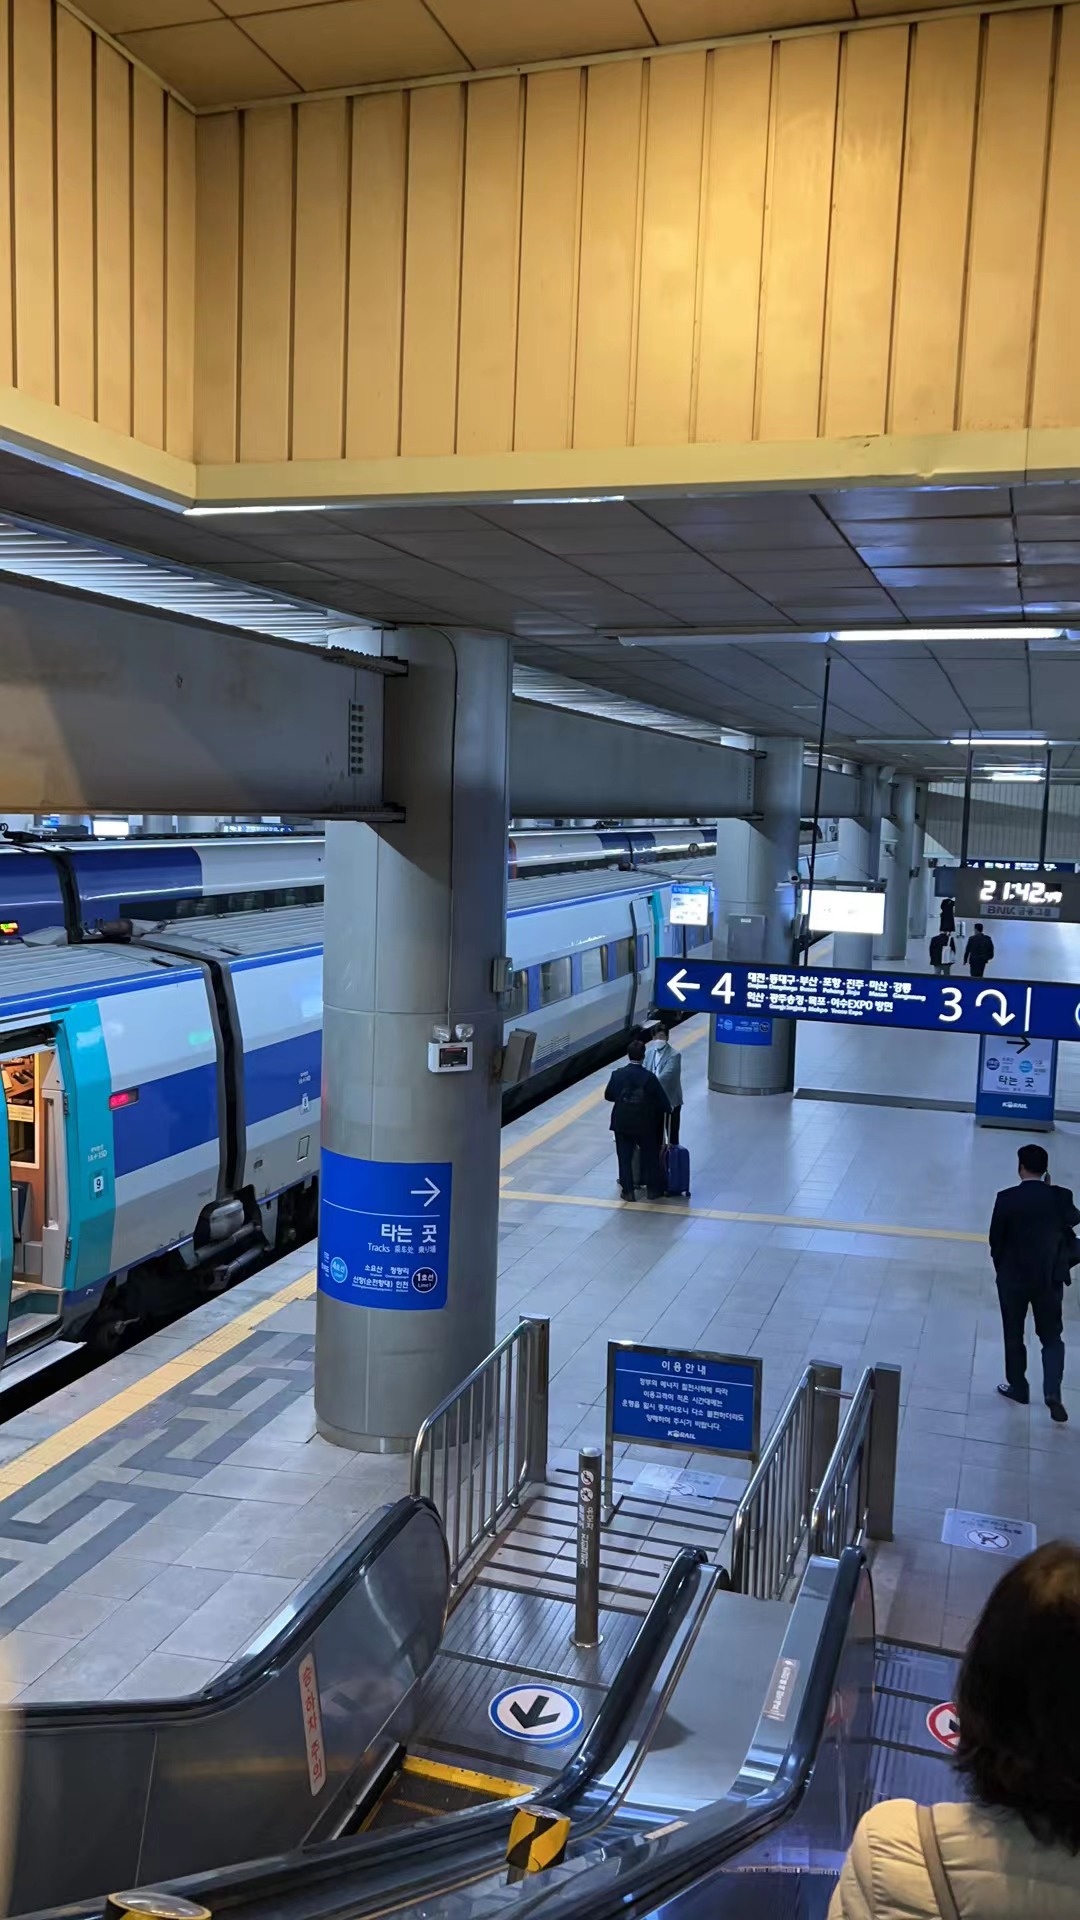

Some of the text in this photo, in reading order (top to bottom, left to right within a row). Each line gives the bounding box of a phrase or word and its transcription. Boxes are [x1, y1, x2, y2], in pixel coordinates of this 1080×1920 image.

[710, 972, 736, 1005] 4
[874, 1001, 894, 1012] 방면
[939, 987, 963, 1022] 3
[381, 1223, 437, 1243] 타는 곳
[367, 1242, 391, 1253] Tracks
[660, 1381, 679, 1390] 에너지
